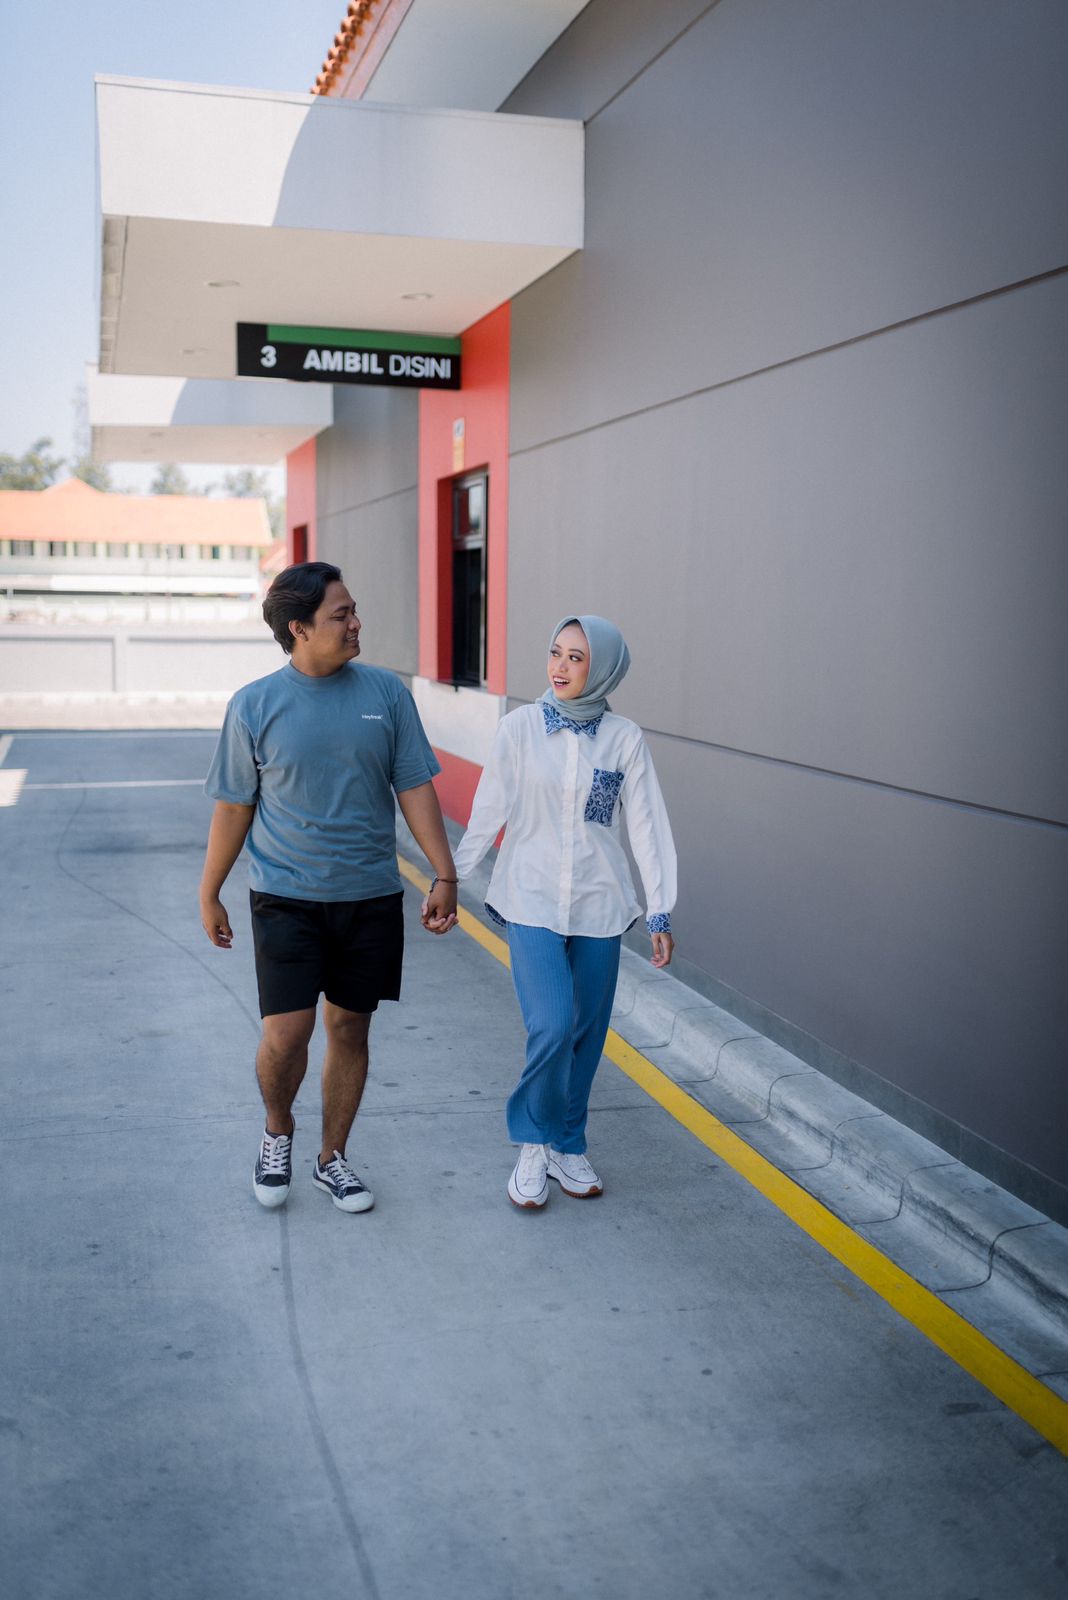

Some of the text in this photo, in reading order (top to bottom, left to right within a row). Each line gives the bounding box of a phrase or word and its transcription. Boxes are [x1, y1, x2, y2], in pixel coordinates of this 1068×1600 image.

[260, 345, 451, 379] 3 AMBIL DISINI
